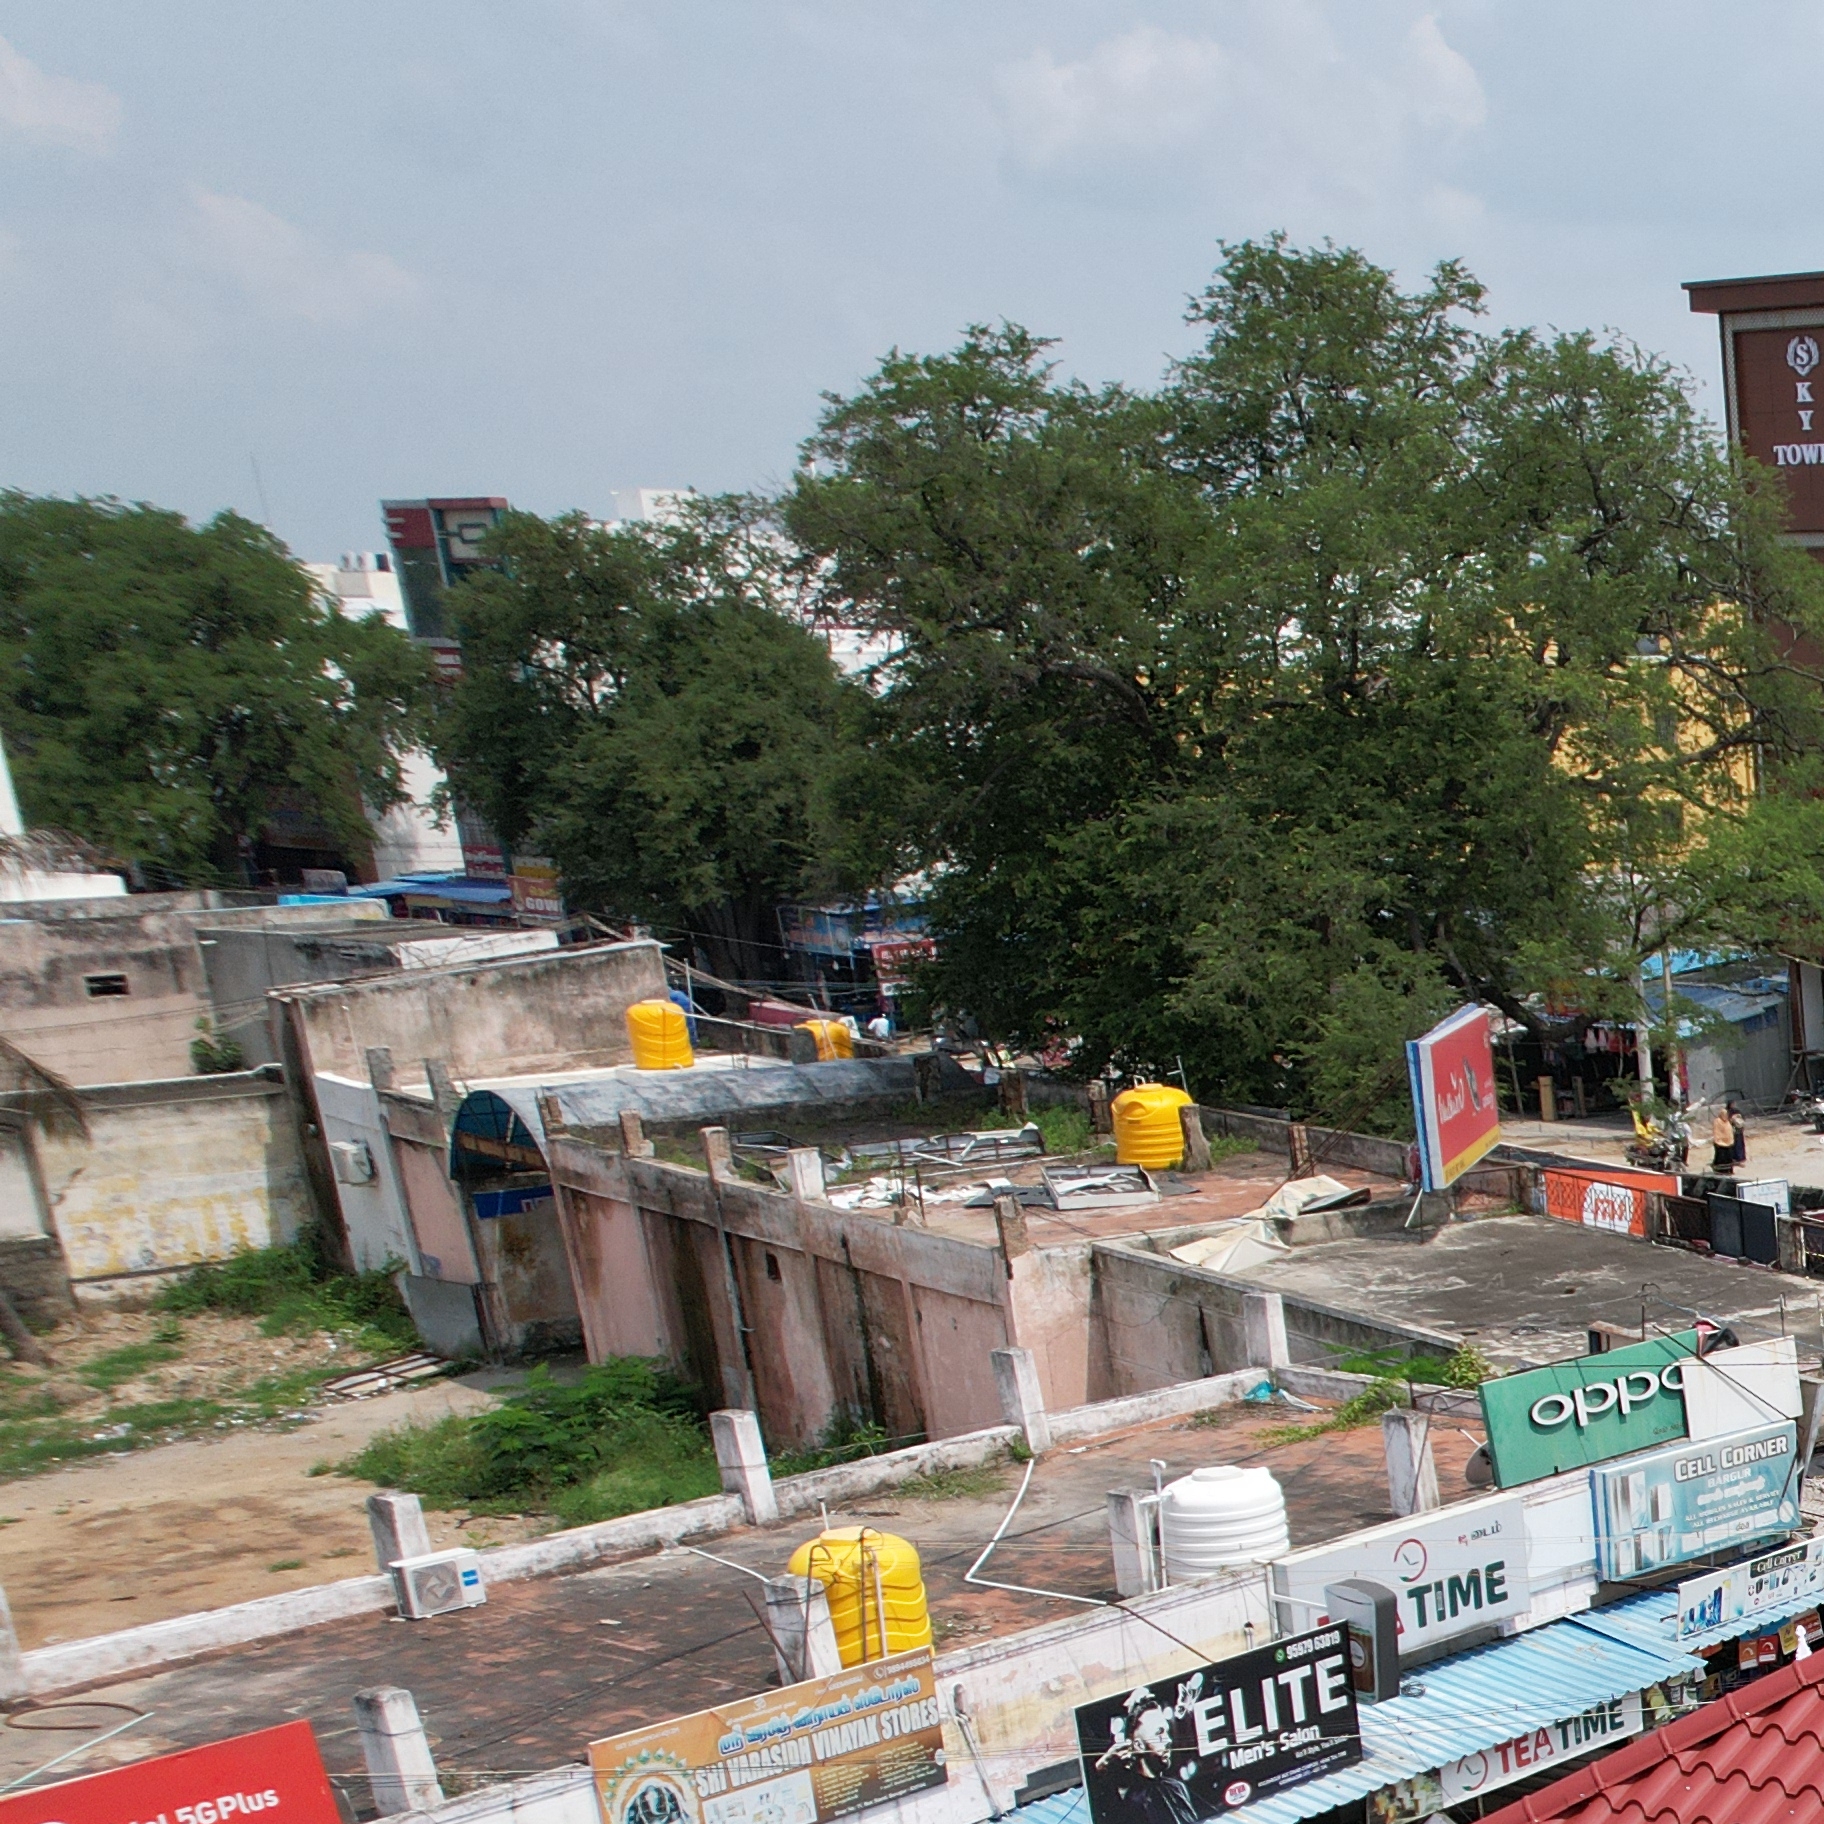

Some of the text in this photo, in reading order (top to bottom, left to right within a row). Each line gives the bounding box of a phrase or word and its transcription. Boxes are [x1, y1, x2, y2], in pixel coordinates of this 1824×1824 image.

[1674, 1434, 1789, 1483] CELL CORNER
[1407, 1560, 1509, 1629] TIME
[811, 1712, 881, 1761] VINAYAK
[880, 1695, 941, 1741] STORES
[1193, 1653, 1349, 1758] ELITE
[1494, 1699, 1626, 1775] TEA TIME
[1229, 1739, 1276, 1771] Men's
[1278, 1724, 1321, 1752] Salon
